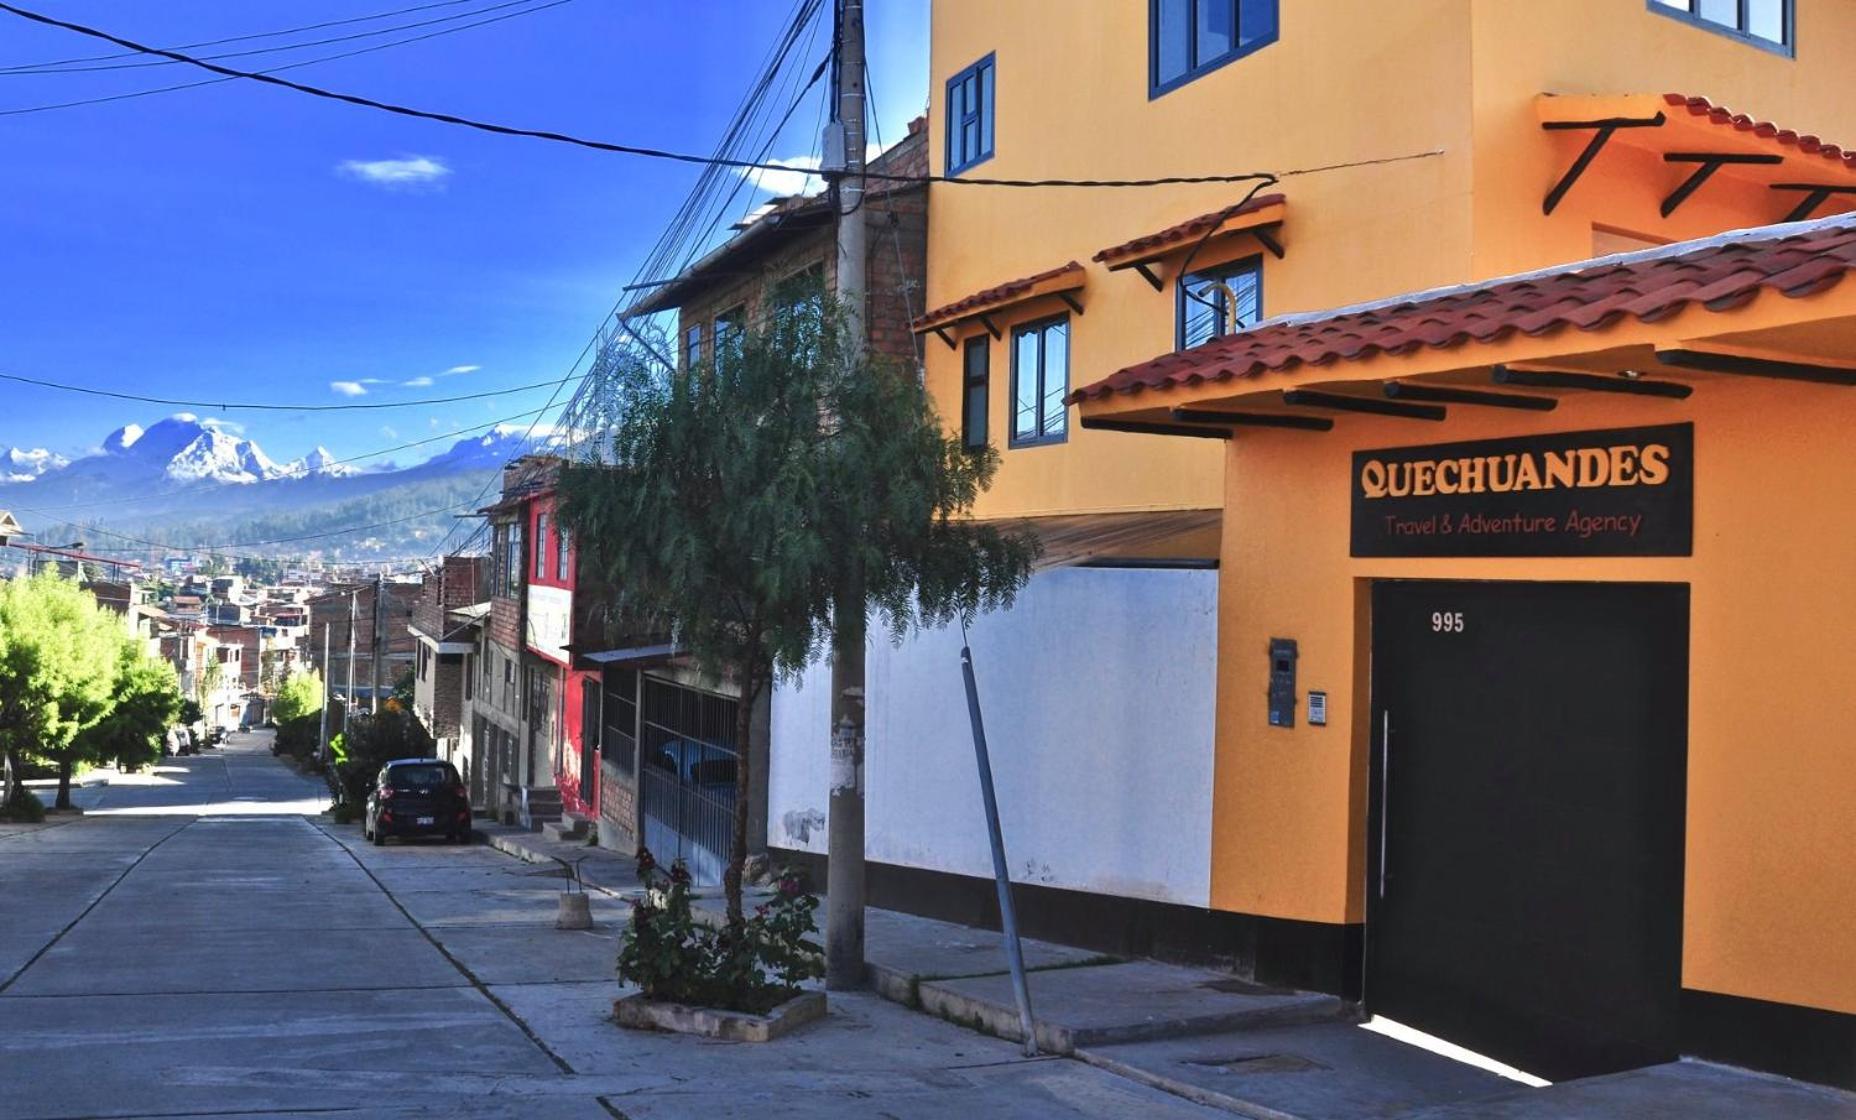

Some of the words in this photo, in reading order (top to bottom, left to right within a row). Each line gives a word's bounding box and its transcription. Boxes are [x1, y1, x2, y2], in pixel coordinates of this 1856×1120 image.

[1361, 443, 1670, 499] QUECHUANDES
[1385, 514, 1437, 537] Travel
[1441, 513, 1453, 534] &
[1458, 511, 1557, 535] Adventure
[1565, 510, 1642, 538] Agency
[1432, 612, 1465, 633] 995
